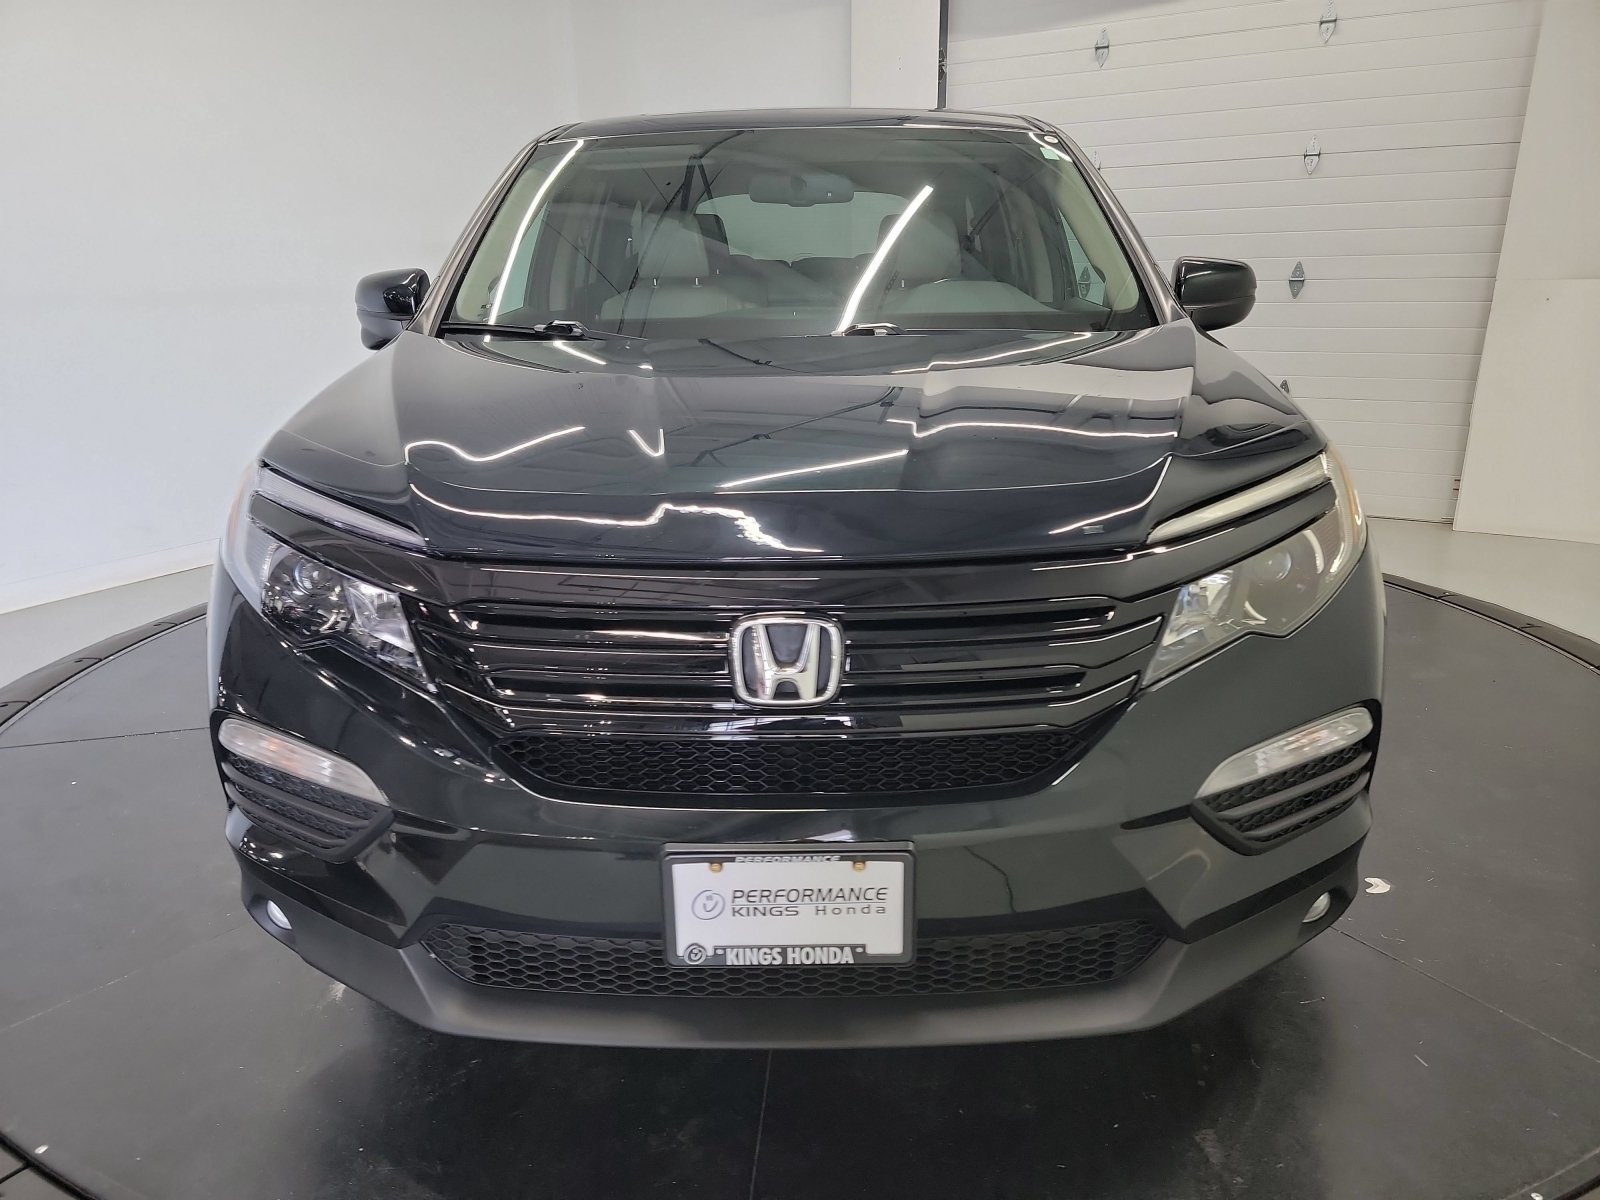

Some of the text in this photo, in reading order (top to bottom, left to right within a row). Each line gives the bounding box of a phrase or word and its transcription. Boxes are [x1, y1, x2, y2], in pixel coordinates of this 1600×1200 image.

[735, 855, 841, 864] PERFORMANCE
[731, 887, 888, 903] PERFORMANCE
[731, 904, 886, 917] KINGS Honda
[725, 947, 855, 965] KINGS HONDA
